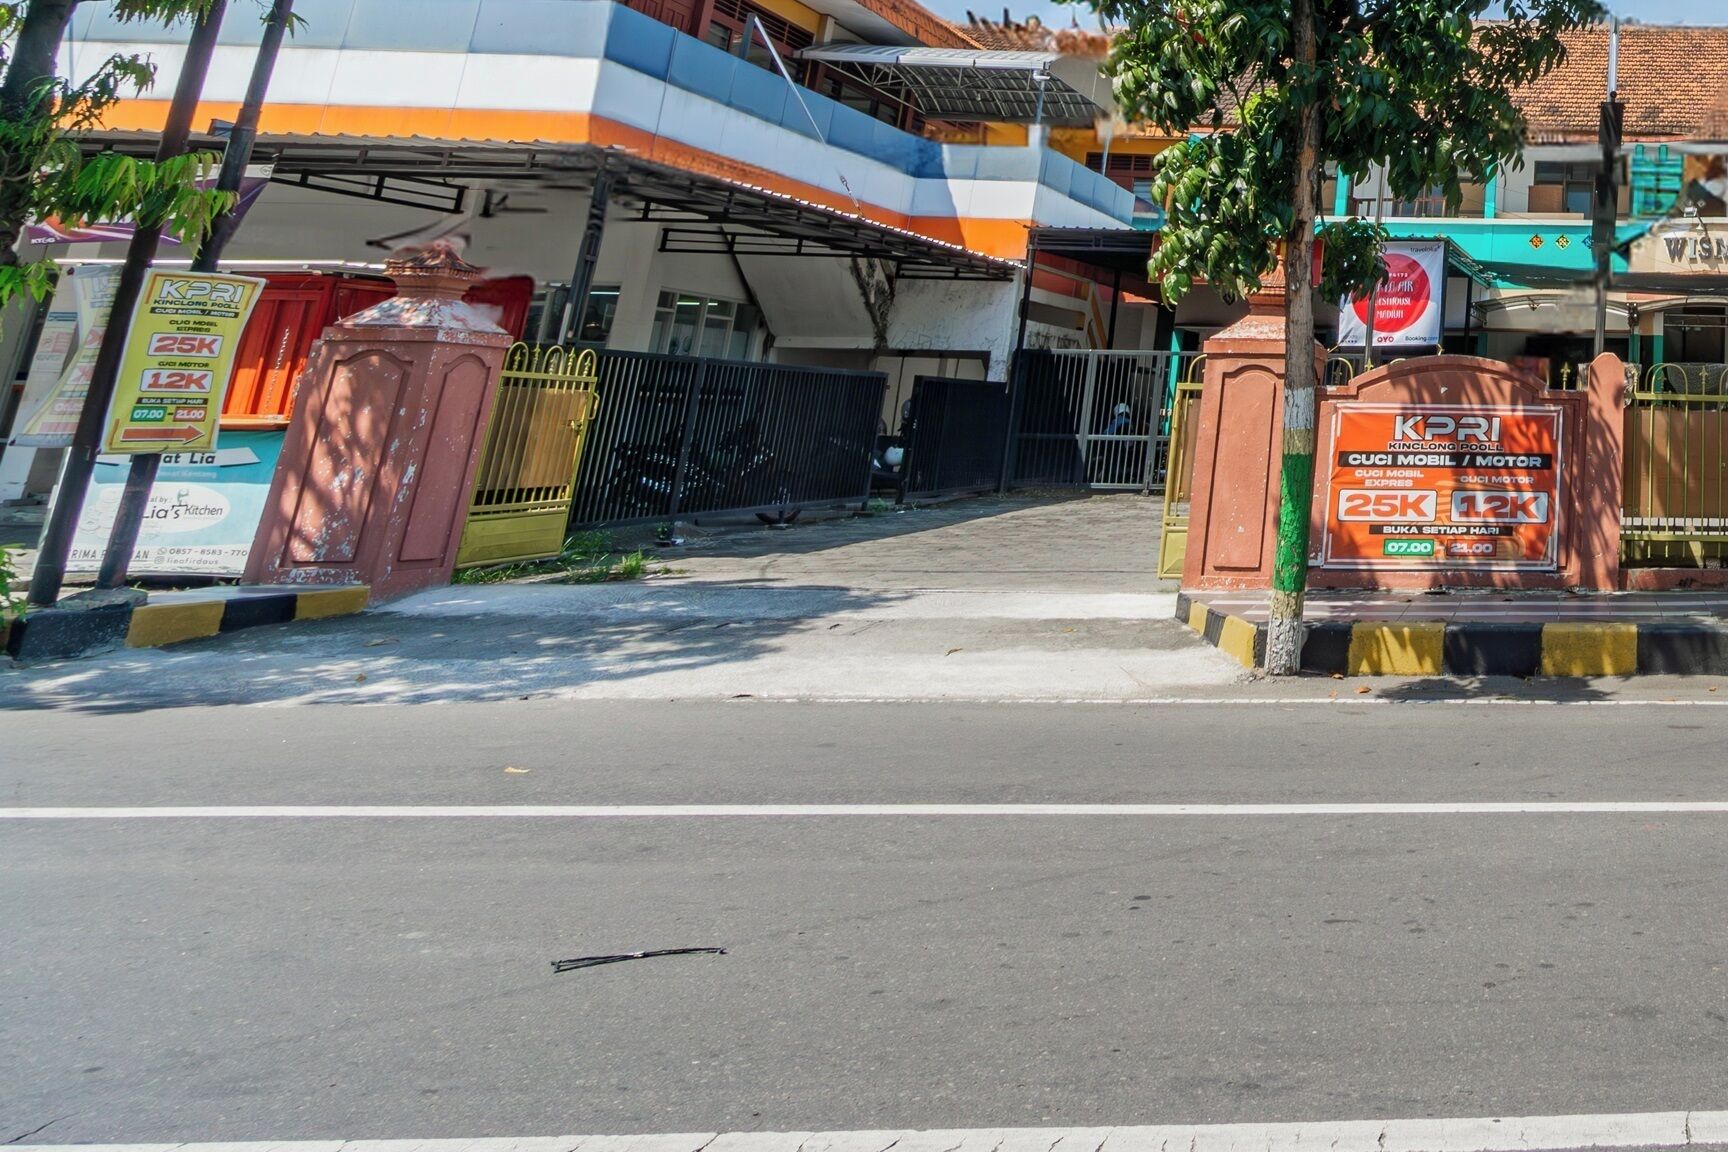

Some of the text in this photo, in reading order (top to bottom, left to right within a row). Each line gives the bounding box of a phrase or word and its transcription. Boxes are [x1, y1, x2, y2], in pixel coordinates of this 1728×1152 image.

[160, 279, 245, 303] KPRI
[154, 299, 208, 308] KINCLONG
[1377, 335, 1394, 343] OYO
[153, 336, 219, 355] 25K
[147, 372, 209, 390] 12K
[132, 409, 164, 419] 07.00
[175, 409, 205, 419] 21.00
[1393, 415, 1501, 442] KPRI
[1387, 442, 1504, 452] KINCLONG POOLL
[189, 453, 216, 464] Lia
[1348, 454, 1392, 466] CUCI
[1396, 454, 1456, 466] MOBIL
[1475, 456, 1542, 468] MOTOR
[1355, 469, 1424, 478] CUCI MOBIL
[1364, 479, 1413, 487] EXPRES
[1460, 475, 1534, 484] CUCI MOTOR
[184, 504, 223, 516] Kitchen
[1344, 493, 1429, 518] 25K
[1458, 495, 1541, 519] 12K
[1383, 526, 1500, 535] BUKA SETIAP HARI
[1387, 543, 1432, 553] 07.00
[1450, 543, 1493, 553] 21.00
[71, 550, 97, 559] RIMA
